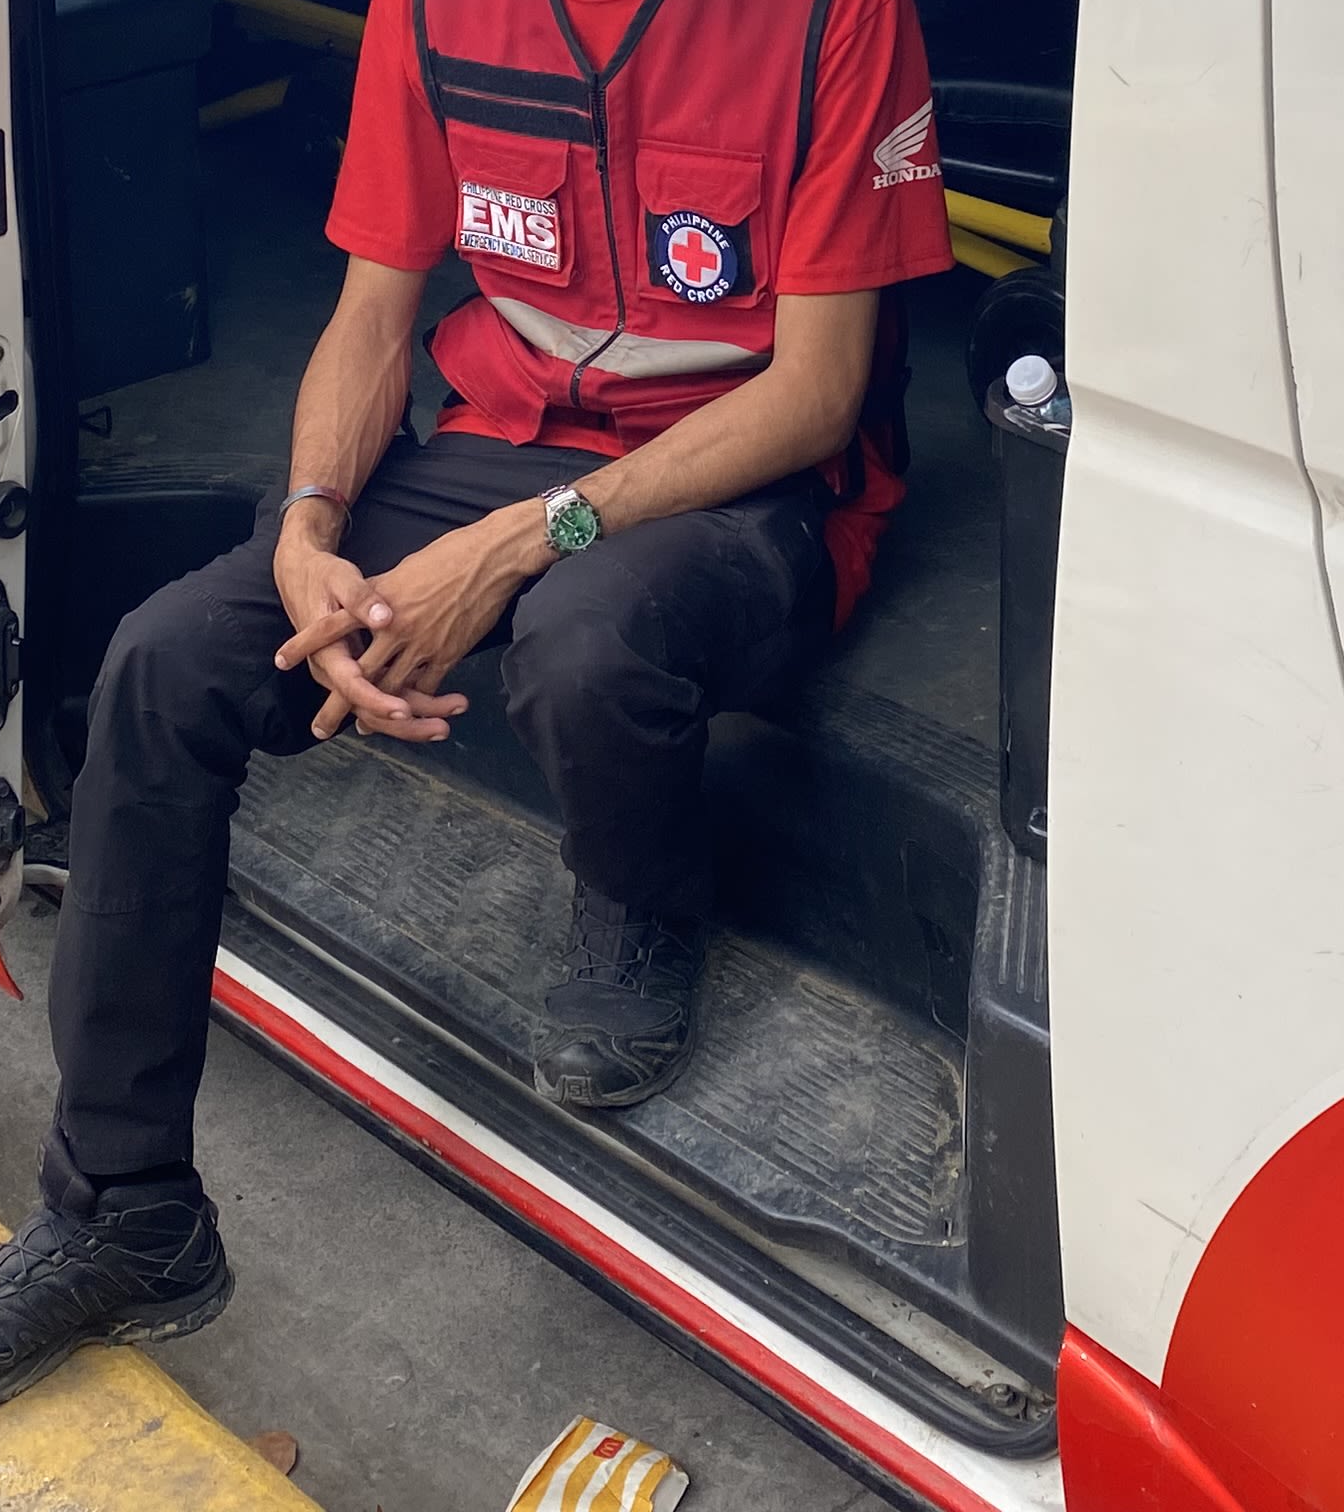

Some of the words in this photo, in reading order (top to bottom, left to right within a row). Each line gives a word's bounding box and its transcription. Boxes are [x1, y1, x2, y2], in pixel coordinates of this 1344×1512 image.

[872, 163, 942, 190] HONDA
[462, 195, 556, 250] EMS
[505, 193, 523, 209] RED
[523, 198, 555, 216] CROSS
[662, 213, 730, 250] PHILIPPINE
[659, 264, 683, 294] RED
[687, 278, 729, 303] CROSS
